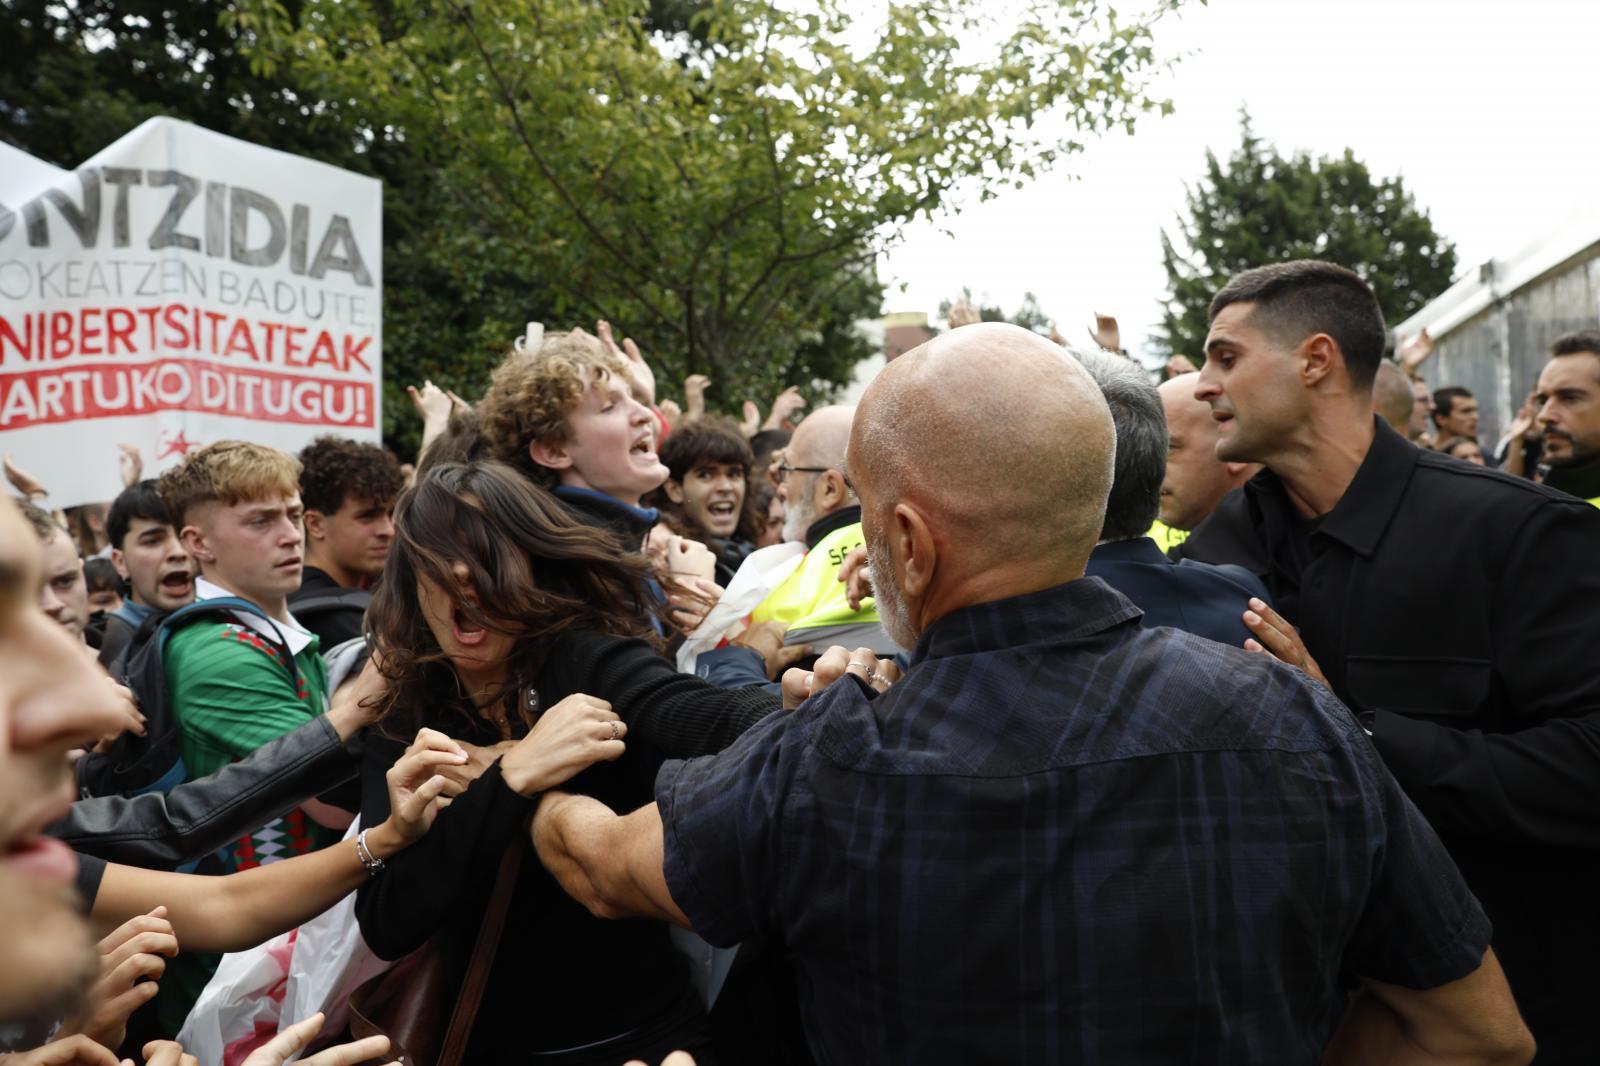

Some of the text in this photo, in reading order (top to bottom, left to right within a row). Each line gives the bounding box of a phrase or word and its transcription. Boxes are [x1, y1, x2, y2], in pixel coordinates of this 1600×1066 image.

[0, 259, 207, 300] OKEATZEN
[0, 303, 373, 374] NIBERTSITATEAK
[0, 362, 368, 425] ARTUKO DITUGU!
